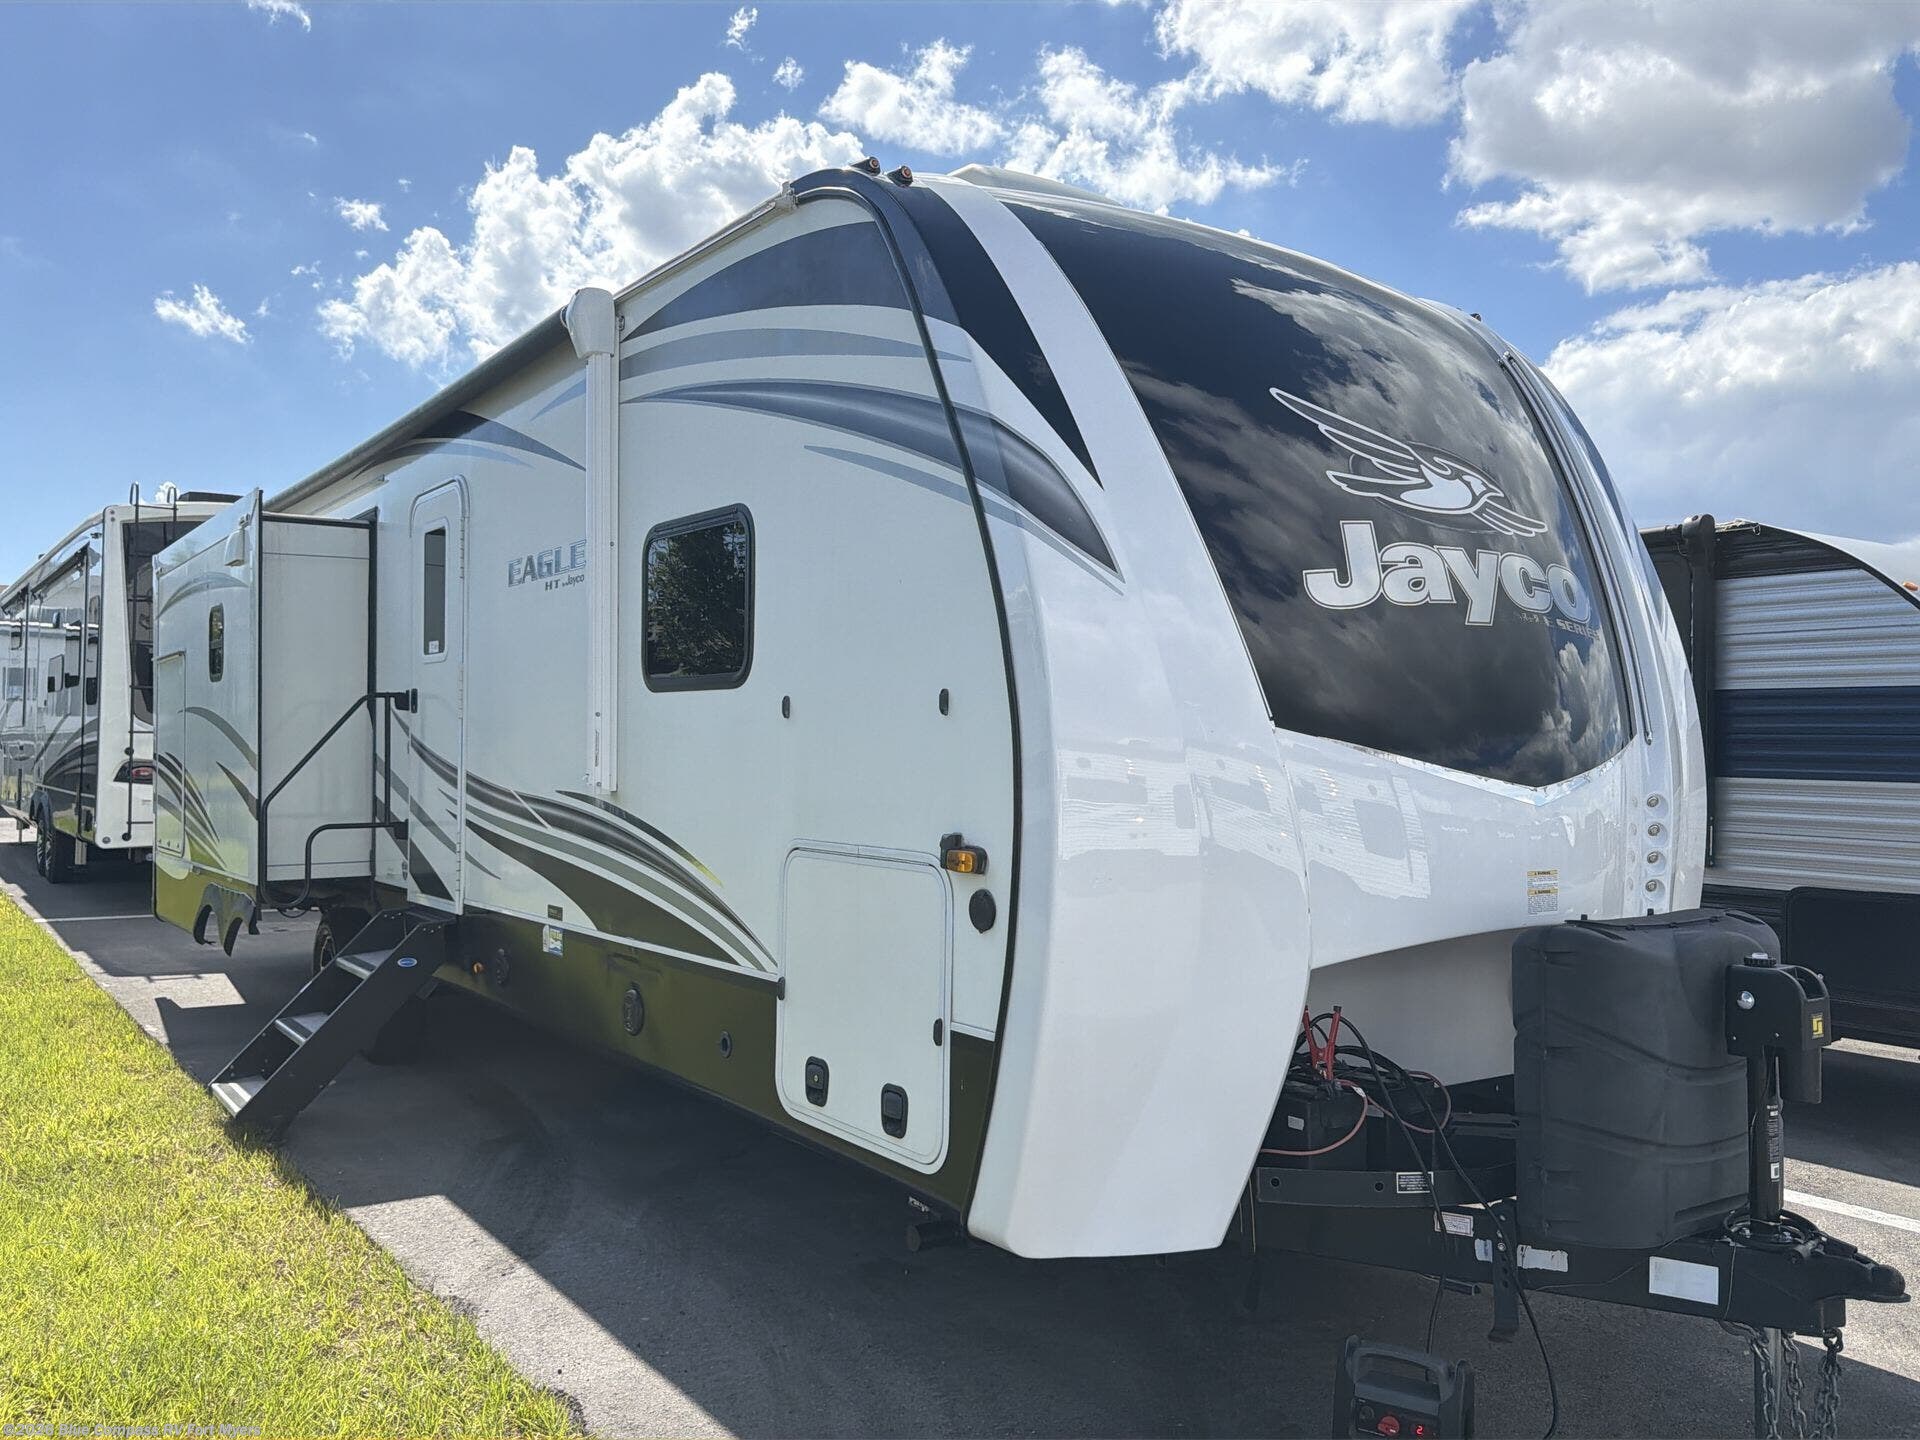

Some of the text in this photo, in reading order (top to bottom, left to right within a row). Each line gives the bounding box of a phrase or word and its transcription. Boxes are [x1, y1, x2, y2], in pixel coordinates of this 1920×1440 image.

[508, 539, 587, 588] EAGLE
[545, 579, 560, 591] HT
[1303, 520, 1590, 626] Jayco
